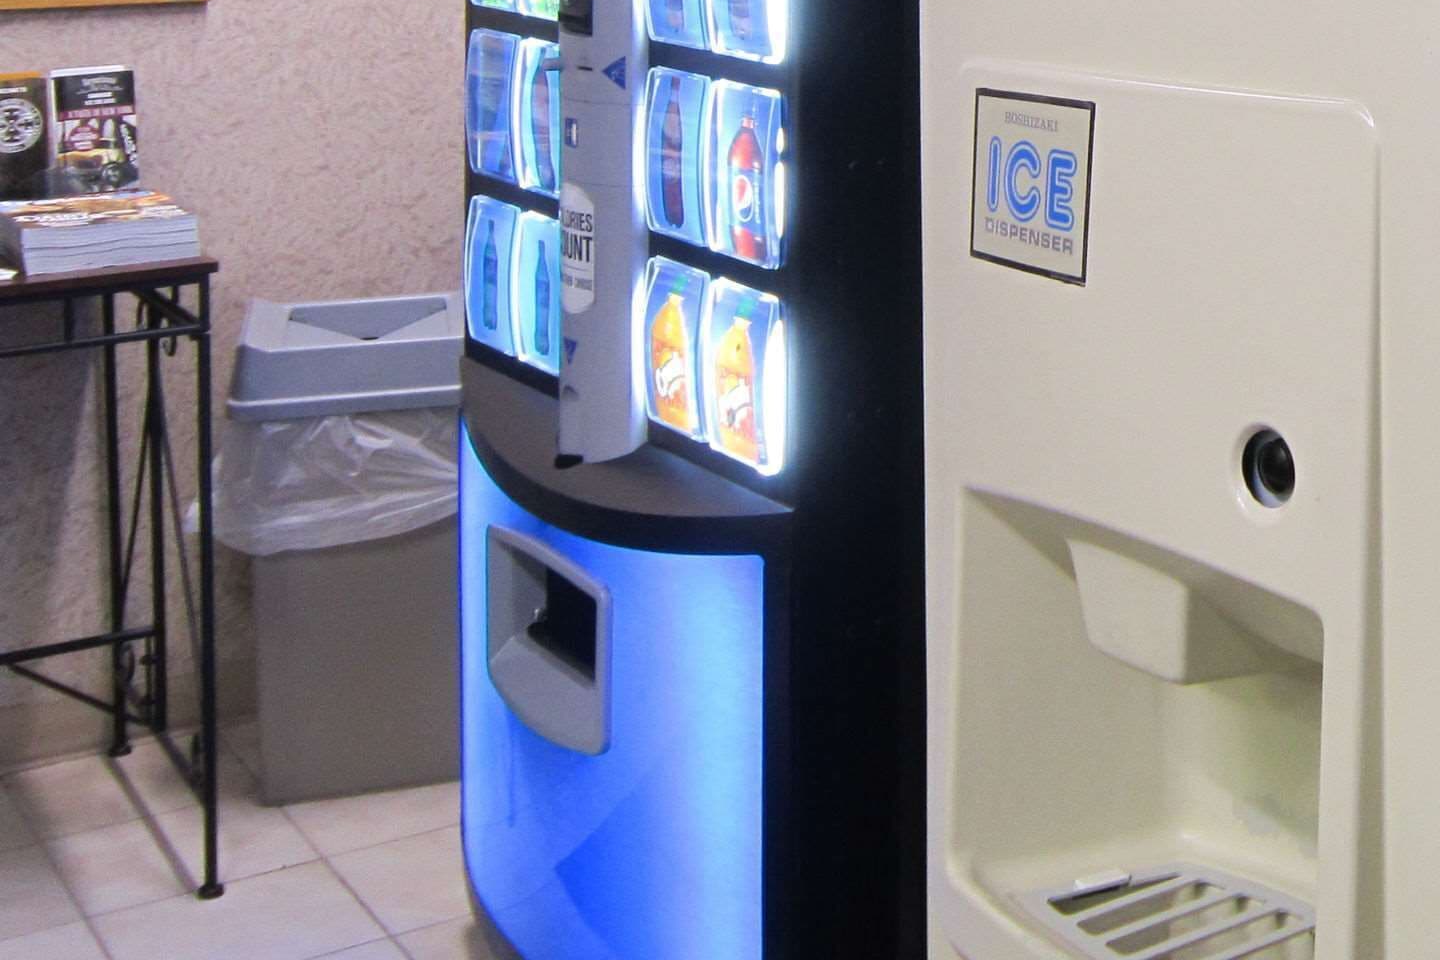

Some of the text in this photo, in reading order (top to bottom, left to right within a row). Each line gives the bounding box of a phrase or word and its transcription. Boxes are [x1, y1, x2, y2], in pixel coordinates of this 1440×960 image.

[1004, 111, 1058, 132] HOSHIZAKI
[987, 135, 1078, 232] ICE
[984, 216, 1074, 257] DISPENSER
